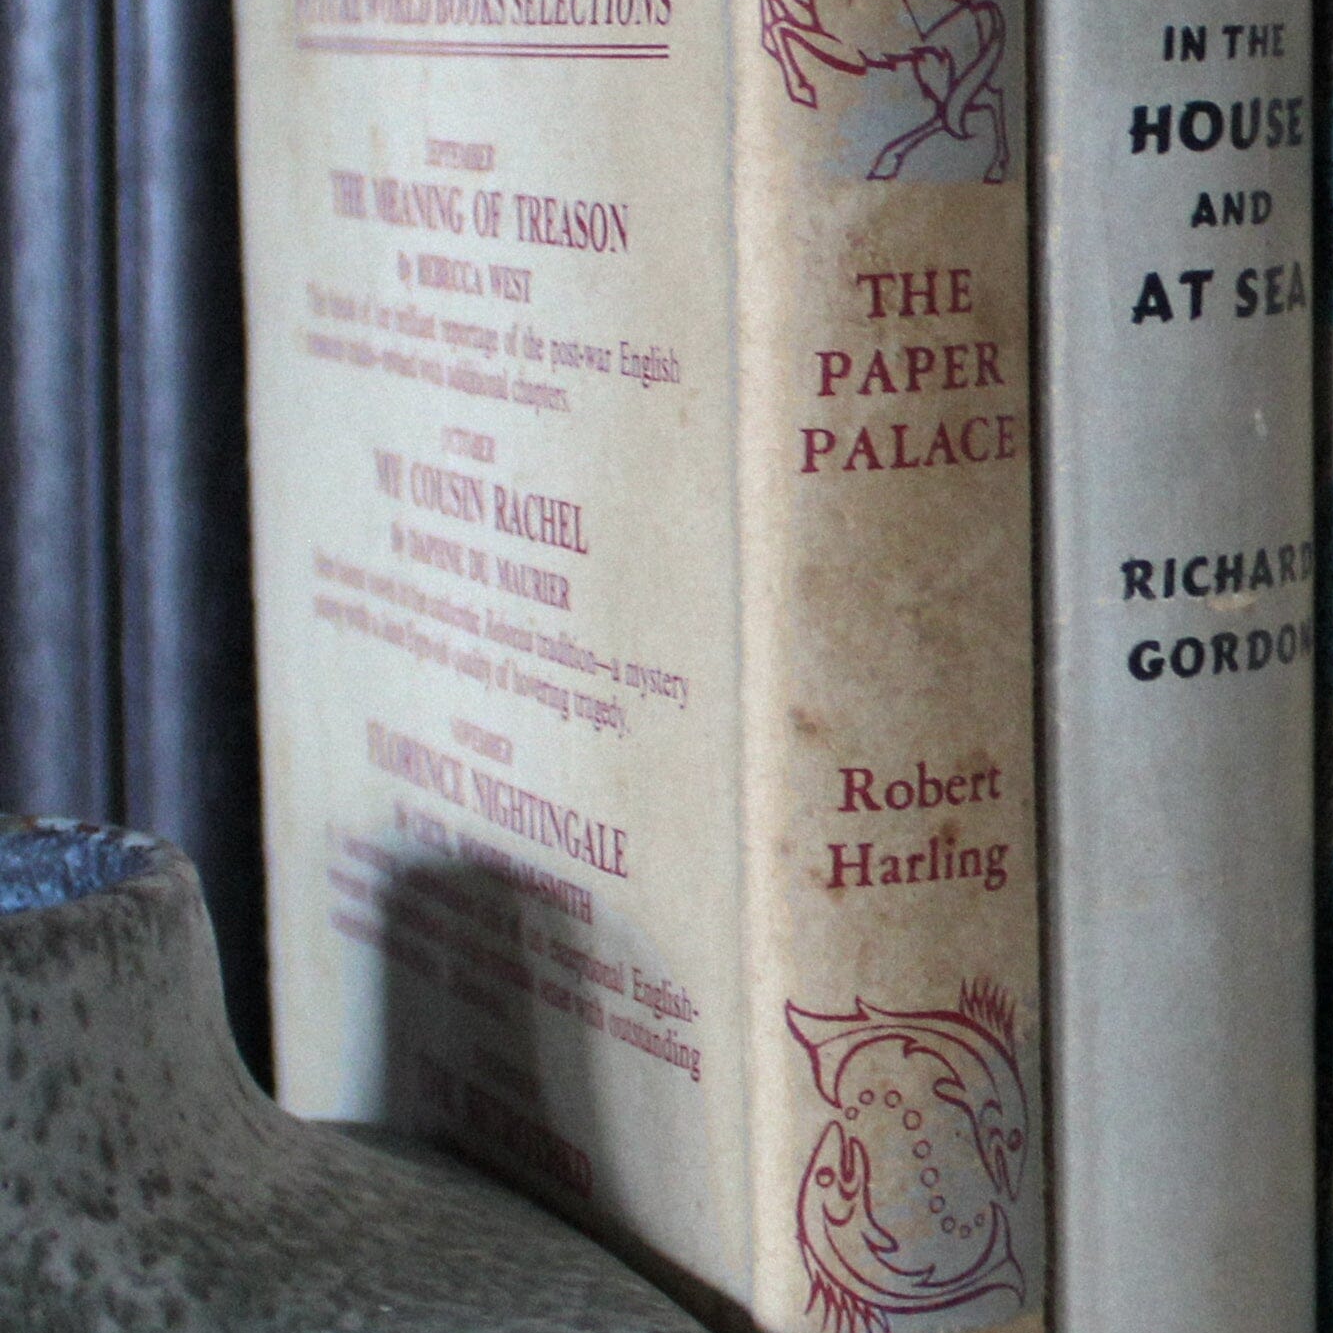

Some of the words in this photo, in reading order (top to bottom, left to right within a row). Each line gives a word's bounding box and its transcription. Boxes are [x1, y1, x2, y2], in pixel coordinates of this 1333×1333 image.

[1163, 25, 1206, 61] IN
[1222, 23, 1285, 59] THE
[1129, 96, 1302, 154] HOUSE
[372, 177, 465, 236] MEANING
[473, 189, 501, 238] OF
[514, 194, 630, 253] TREASON
[1191, 190, 1272, 228] AND
[488, 264, 533, 303] WEST
[856, 268, 972, 318] THE
[1131, 269, 1214, 324] AT
[1235, 261, 1307, 318] SEA
[620, 340, 681, 388] English
[815, 341, 1004, 397] PAPER
[800, 415, 1018, 473] PALACE
[410, 460, 487, 524] COUSIN
[494, 484, 589, 555] RACHEL
[497, 555, 571, 610] MAURIER
[625, 660, 690, 710] mystery
[837, 761, 1002, 813] Robert
[471, 766, 628, 879] NIGHTINGALE
[826, 836, 1009, 892] Harling
[632, 967, 699, 1023] English-
